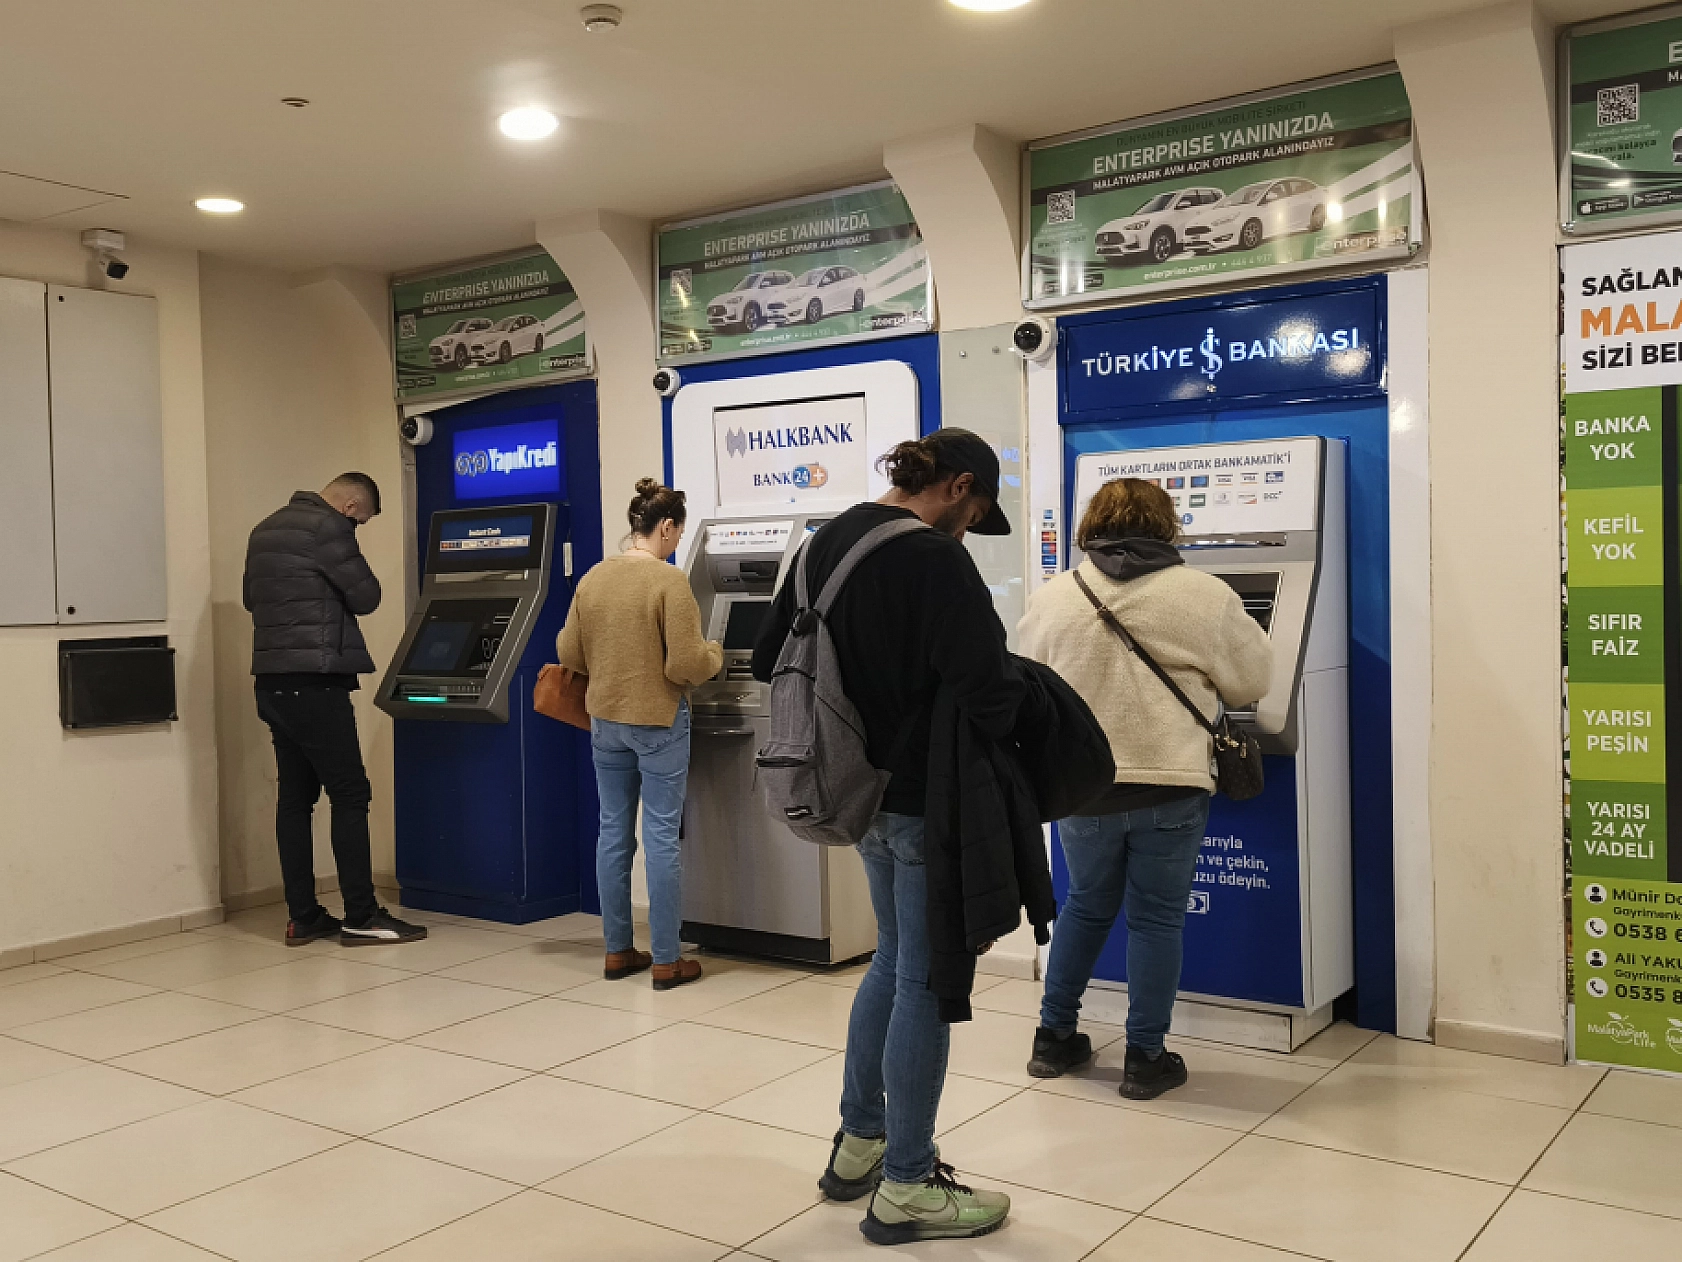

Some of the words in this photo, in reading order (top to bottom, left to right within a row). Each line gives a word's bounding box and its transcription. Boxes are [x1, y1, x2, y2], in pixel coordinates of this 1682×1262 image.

[1218, 109, 1262, 126] MOBLİTE
[1093, 134, 1214, 175] ENTERPRISE
[1219, 111, 1335, 149] YANINIZDA
[1092, 168, 1161, 190] MALATYAPARK
[1164, 163, 1185, 177] AVM
[1187, 161, 1210, 174] AÇIK
[1213, 150, 1260, 167] OTOPARK
[1262, 135, 1335, 158] ALANINDAYIZ
[704, 227, 788, 256] ENTERPRISE
[790, 213, 870, 240] YANINIZDA
[423, 281, 490, 304] ENTERPRISE
[491, 270, 549, 292] YANINIZDA
[1082, 345, 1193, 377] TÜRKİYE
[1229, 327, 1359, 361] BANKASI
[1582, 342, 1632, 371] SİZİ
[1641, 341, 1682, 365] BE
[1574, 415, 1651, 437] BANKA
[748, 422, 853, 451] HALKBANK
[488, 441, 557, 475] YapıKredi
[1590, 441, 1636, 461] YOK
[1098, 464, 1118, 477] TÜM
[1121, 461, 1176, 476] KARTLARIN
[1178, 458, 1212, 472] ORTAK
[753, 471, 792, 487] BANK
[1584, 513, 1644, 535] KEFİL
[1591, 542, 1636, 560] YOK
[1588, 613, 1642, 630] SIFIR
[1591, 636, 1639, 656] FAİZ
[1583, 709, 1652, 728] YARISI
[1587, 732, 1649, 754] PEŞİN
[1586, 801, 1650, 819] YARISI
[1591, 821, 1614, 837] 24
[1620, 823, 1647, 839] AY
[1584, 840, 1655, 860] VADELİ
[1207, 855, 1223, 867] ve
[1227, 855, 1269, 872] çekin,
[1218, 870, 1271, 891] ödeyin.
[1613, 888, 1660, 904] Münir
[1613, 923, 1668, 942] 0538
[1614, 952, 1635, 965] Ali
[1640, 954, 1682, 970] YAK
[1614, 969, 1682, 984] Gayrimenk
[1615, 983, 1665, 1003] 0535
